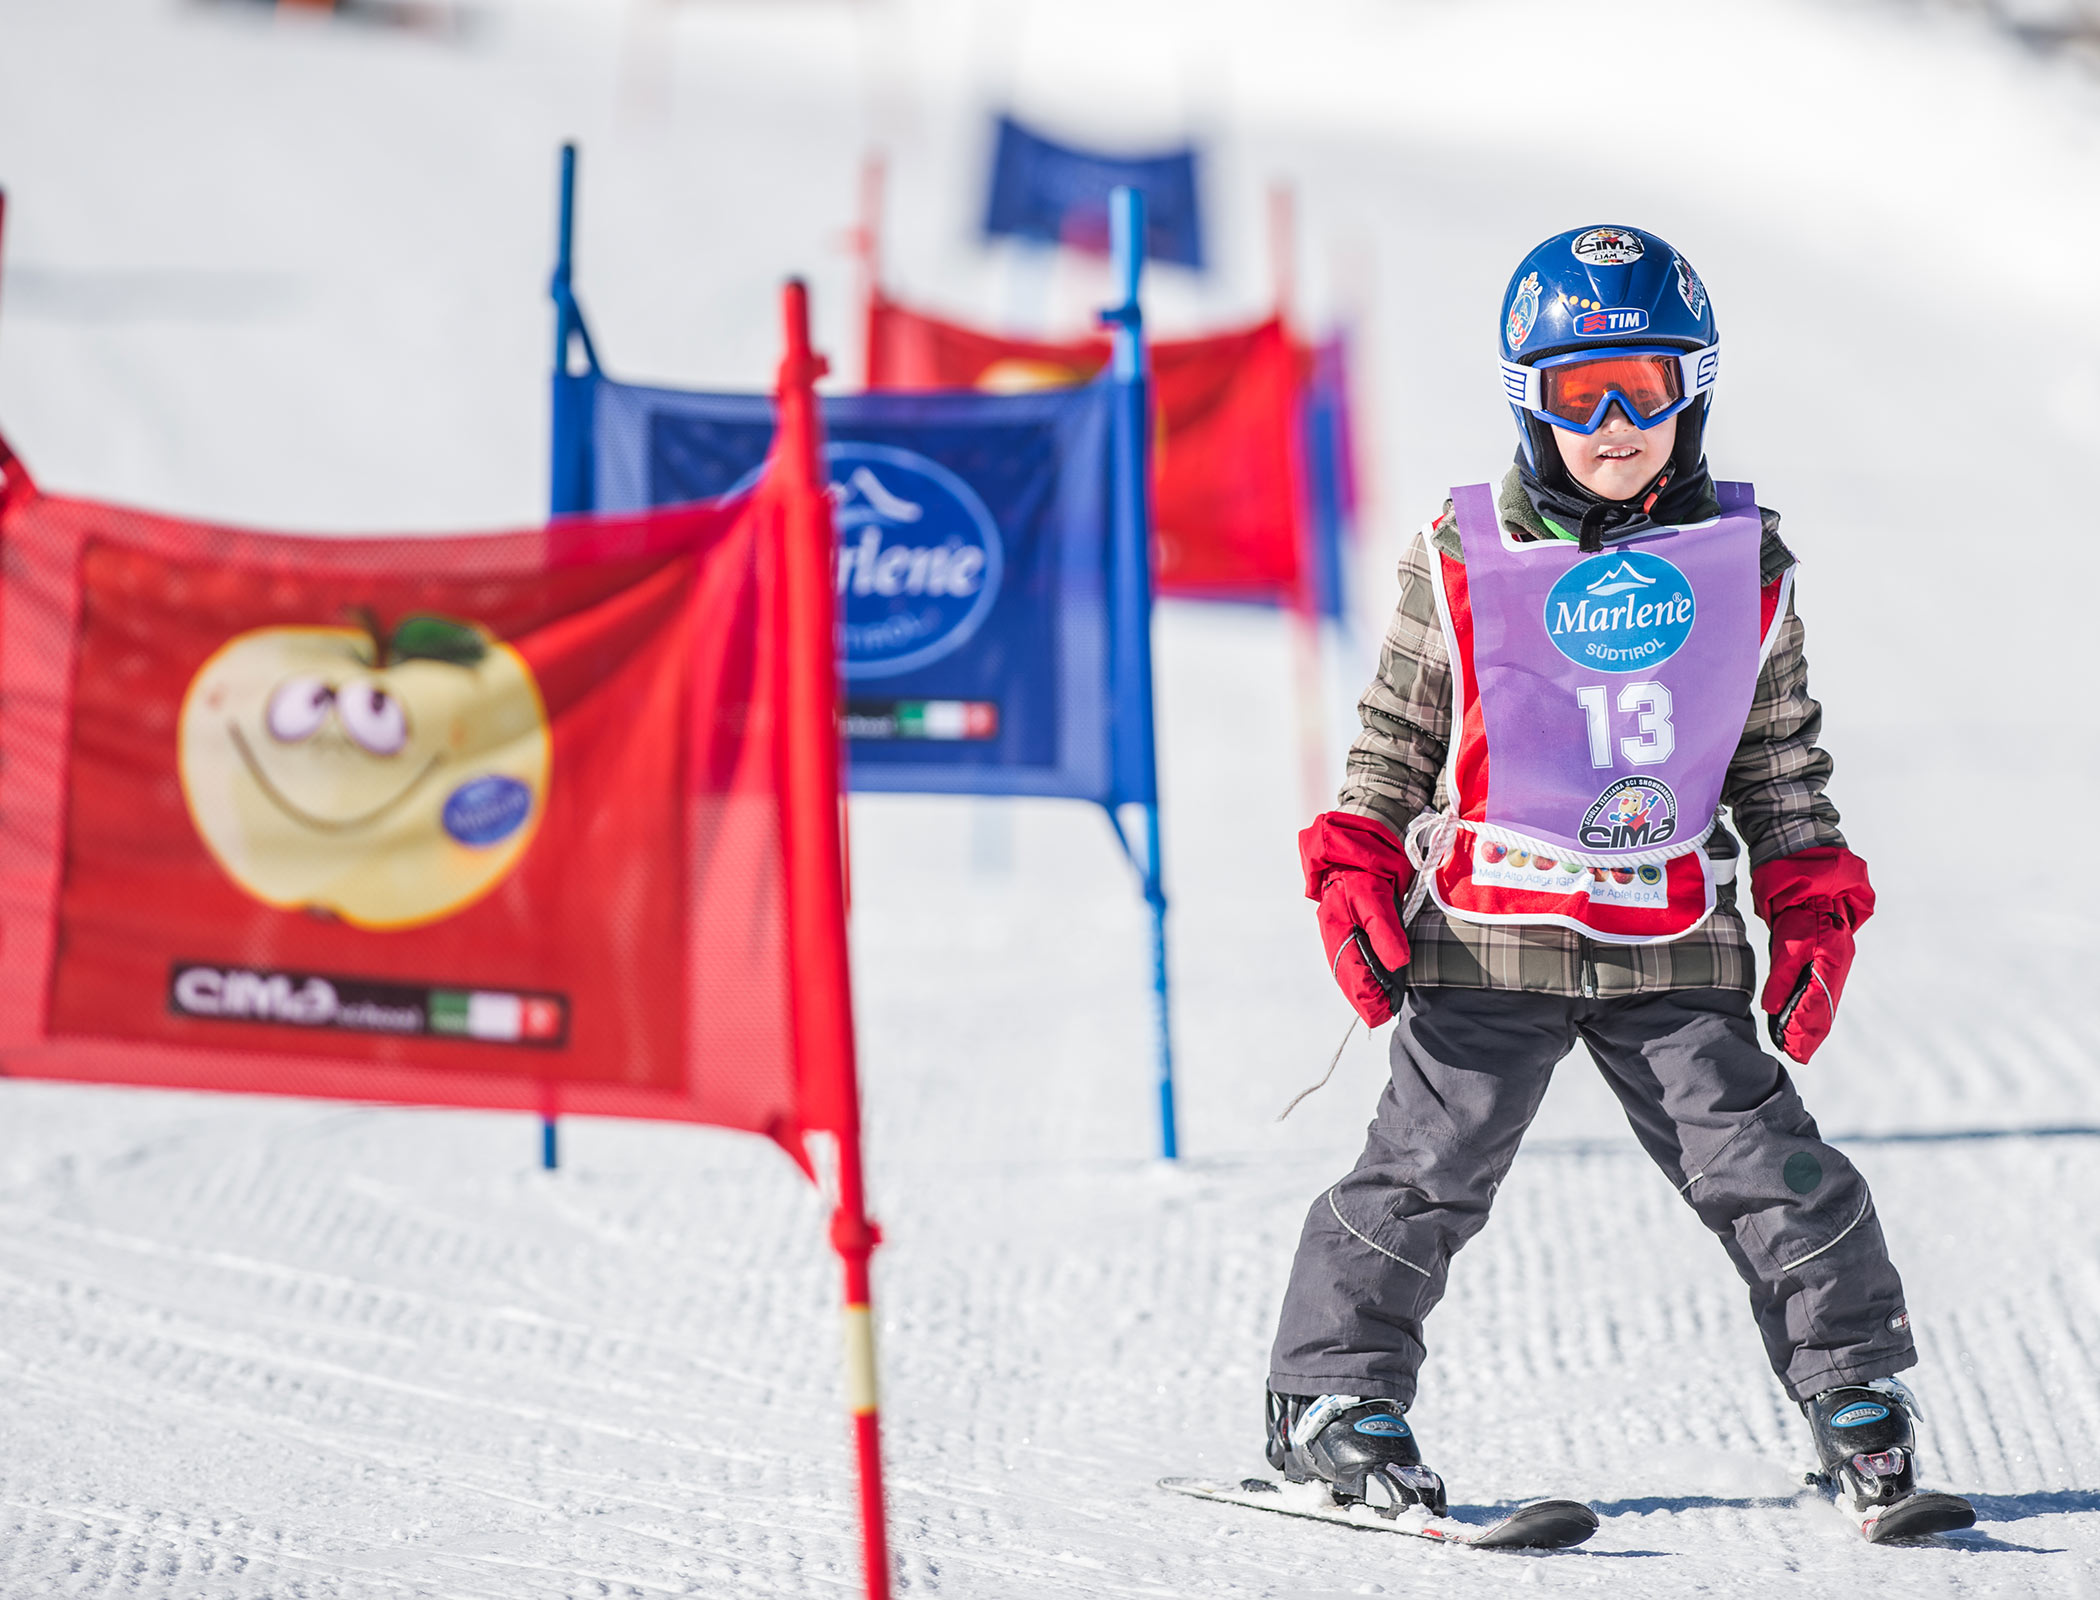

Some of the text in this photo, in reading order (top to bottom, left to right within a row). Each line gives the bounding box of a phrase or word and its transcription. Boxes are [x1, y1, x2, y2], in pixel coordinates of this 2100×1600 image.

[1608, 312, 1640, 329] TIM
[1585, 637, 1666, 661] SÜDTIROL
[1576, 681, 1675, 769] 13
[1584, 805, 1601, 826] SCUOLA
[1600, 783, 1625, 806] ITALIANA
[1625, 779, 1637, 787] SCI
[1479, 868, 1575, 887] Mela Alto Adige IGP
[1607, 888, 1632, 900] Apfel
